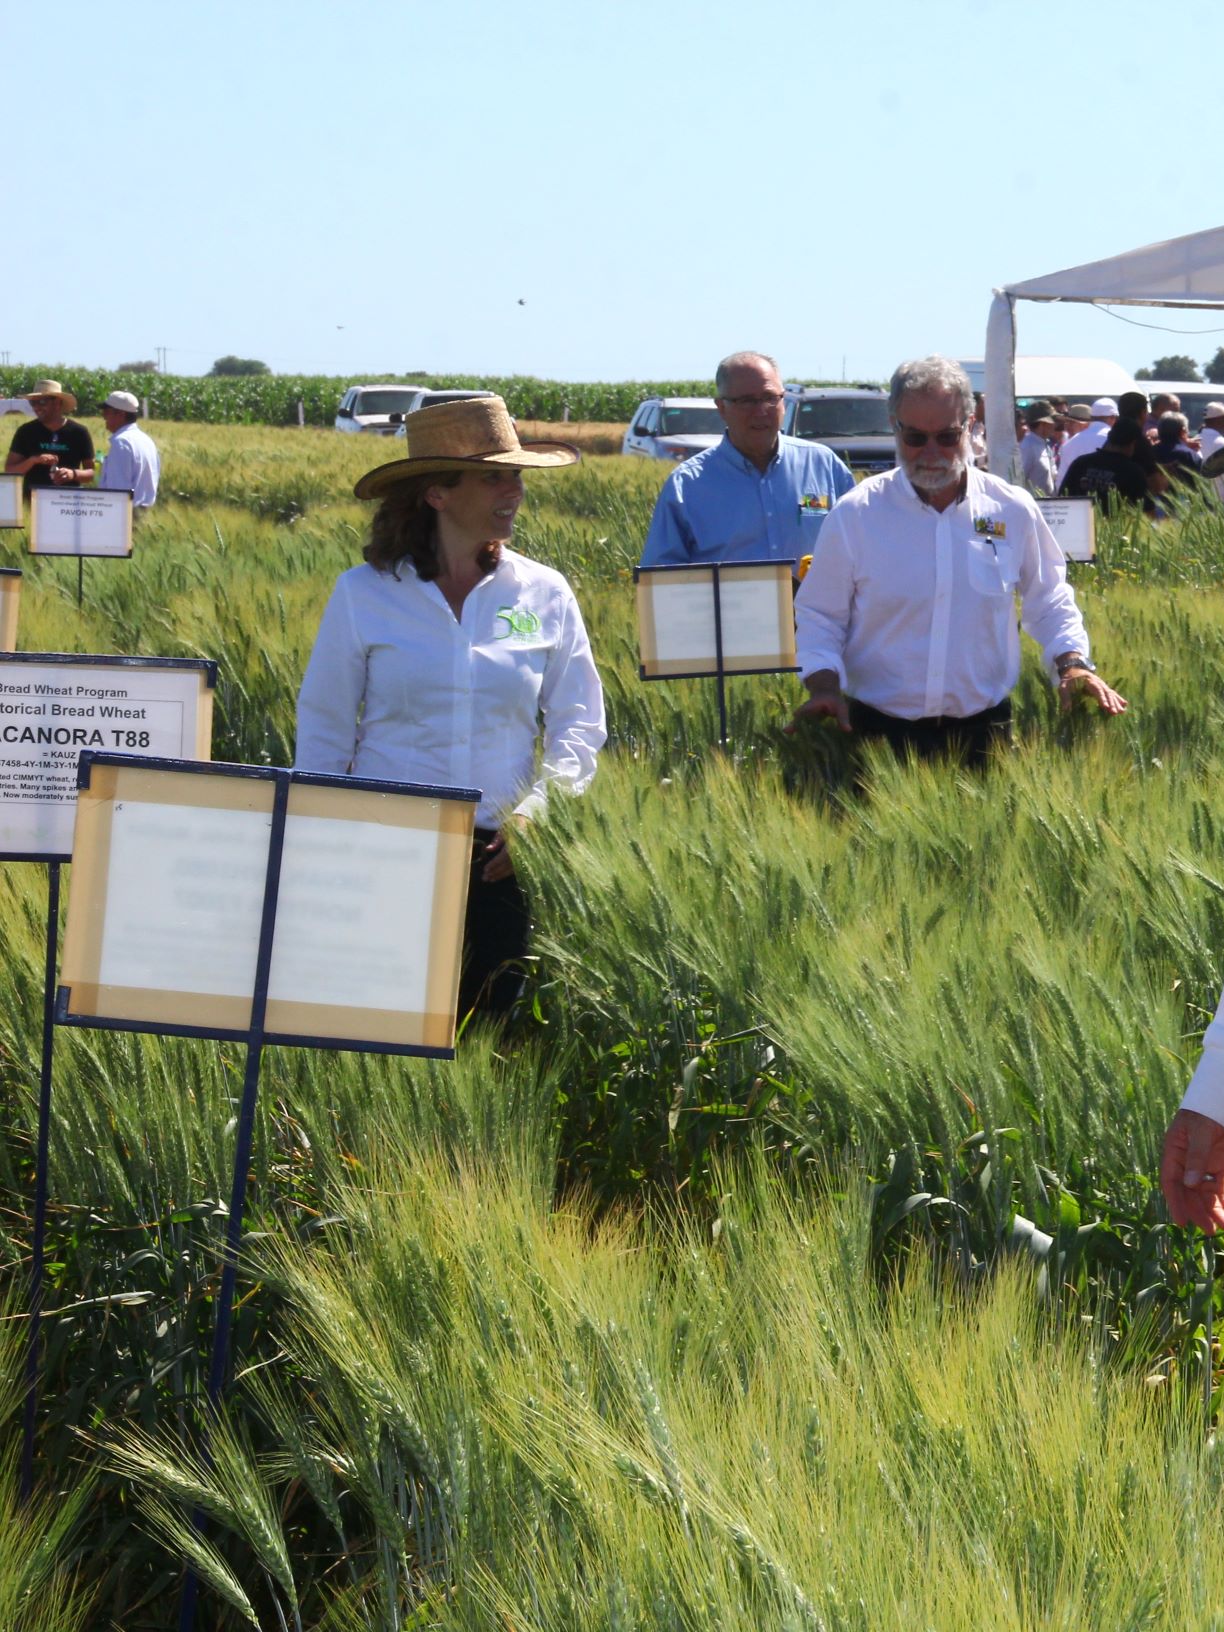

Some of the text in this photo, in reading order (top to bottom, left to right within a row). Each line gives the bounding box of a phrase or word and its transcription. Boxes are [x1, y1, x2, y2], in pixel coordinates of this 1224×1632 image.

[60, 509, 88, 517] PAVON
[34, 684, 73, 696] Wheat
[76, 686, 128, 699] Program
[51, 704, 95, 717] Bread
[100, 706, 147, 719] Wheat
[0, 725, 150, 748] CANORA T88
[50, 751, 77, 760] KAUZ
[0, 759, 79, 770] 7458-4Y-1M-3Y-1M
[13, 774, 44, 782] CIMMYT
[20, 783, 40, 793] Many
[42, 785, 67, 793] spikes
[22, 792, 63, 801] moderately
